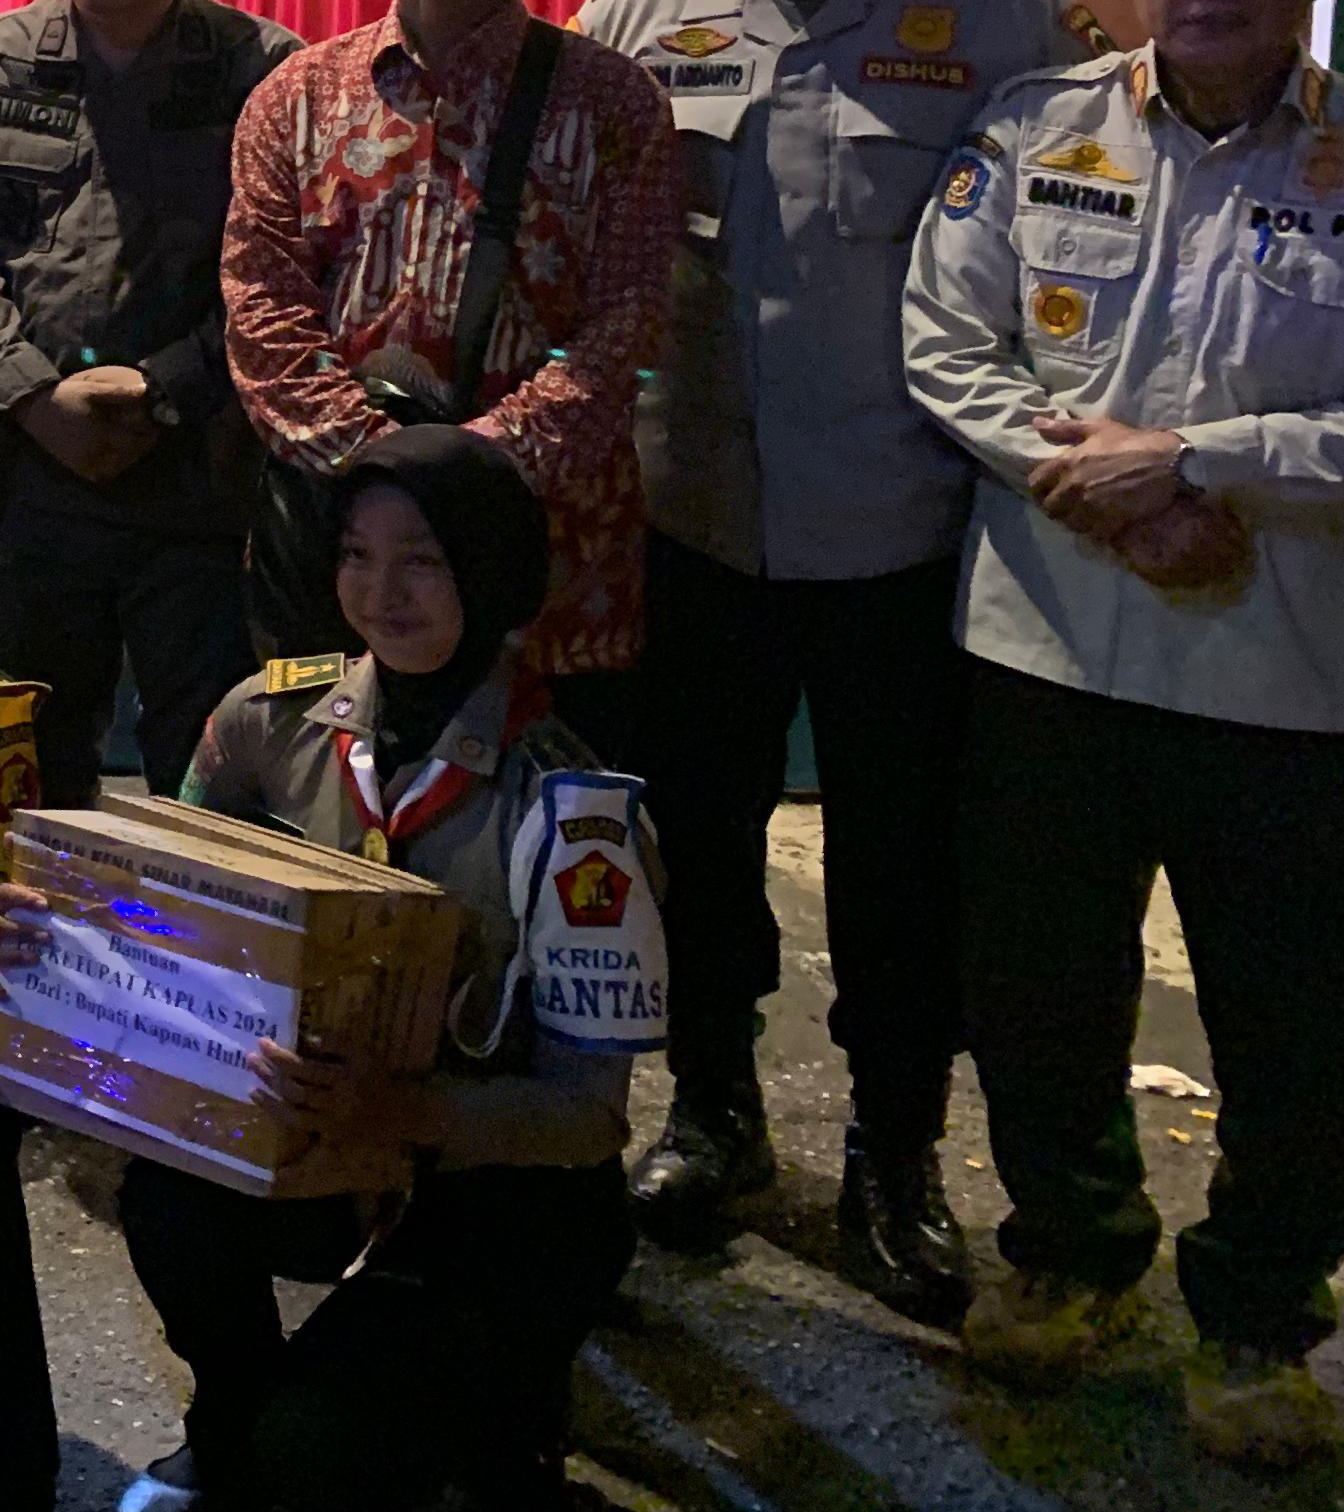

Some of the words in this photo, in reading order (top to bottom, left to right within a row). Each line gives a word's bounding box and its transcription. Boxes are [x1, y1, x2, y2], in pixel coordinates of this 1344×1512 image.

[865, 61, 965, 84] DISHUB
[109, 934, 182, 974] Bantuan
[545, 946, 642, 971] KRIDA
[25, 972, 62, 1001] Dari
[76, 991, 130, 1028] Bupati
[133, 1012, 201, 1053] Kapuas
[47, 948, 135, 992] KETUPAT
[142, 978, 229, 1025] KAPUAS
[233, 1010, 279, 1041] 2024
